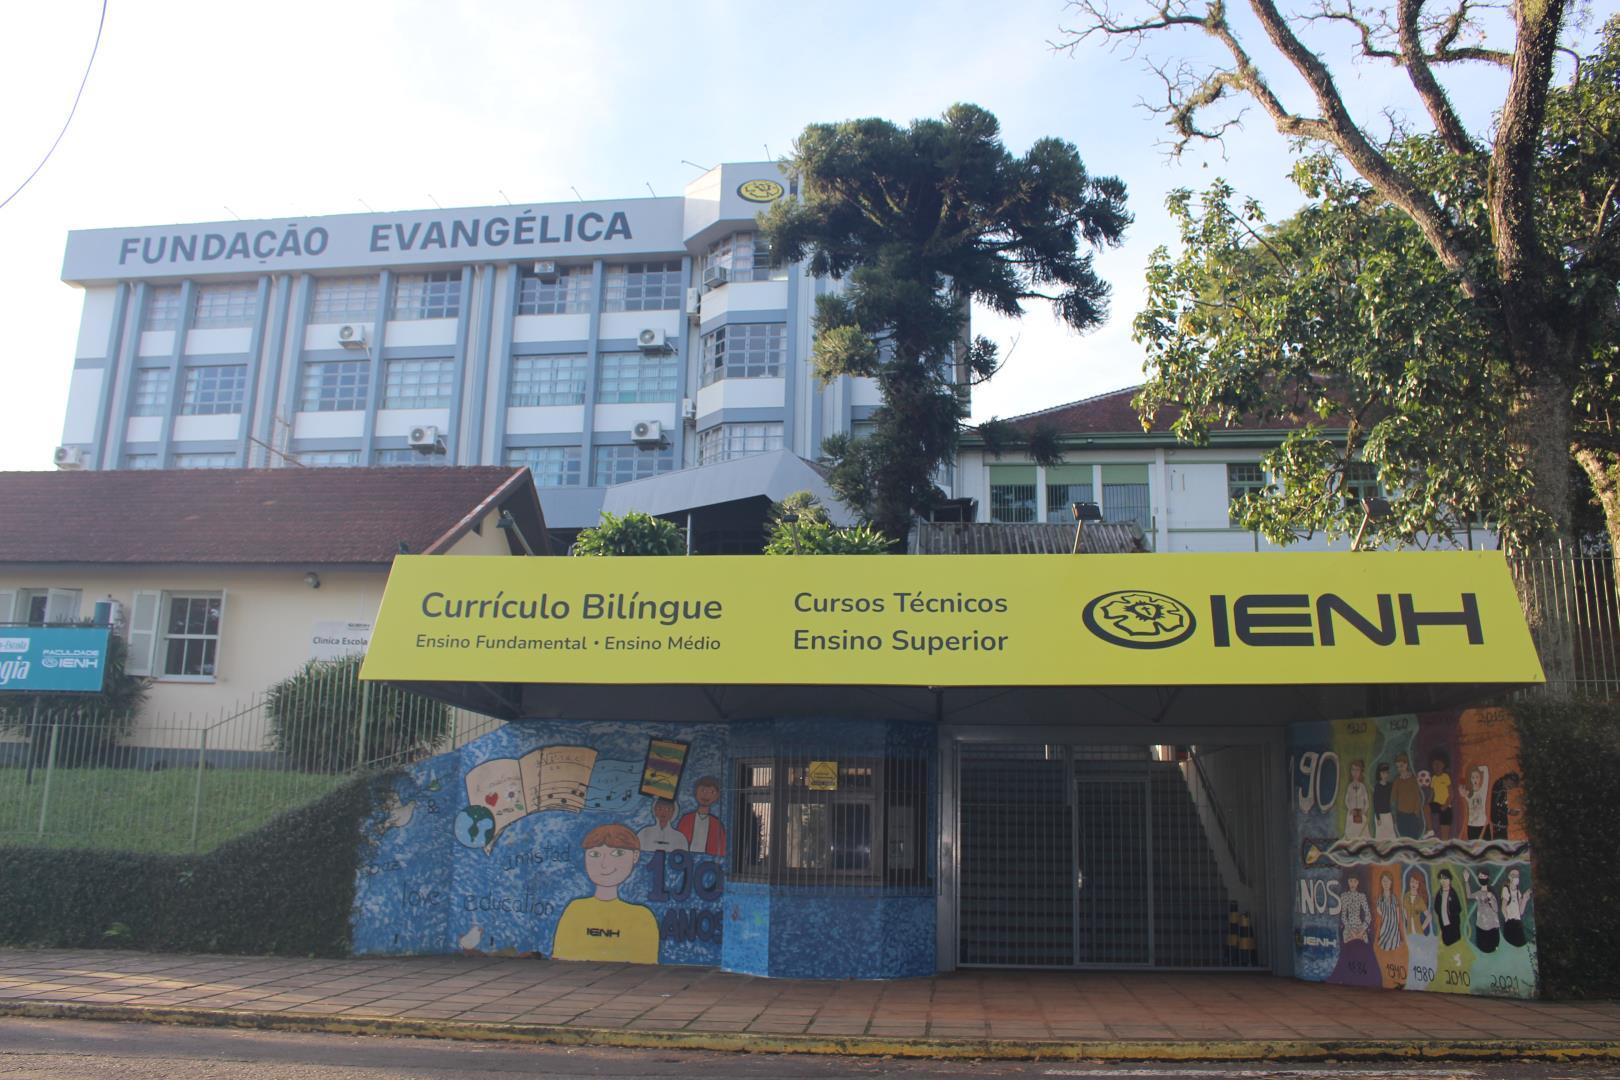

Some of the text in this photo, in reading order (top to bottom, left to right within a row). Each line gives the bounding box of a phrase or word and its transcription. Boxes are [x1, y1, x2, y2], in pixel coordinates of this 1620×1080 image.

[118, 209, 634, 266] FUNDAÇÃO EVANGÉLICA
[421, 590, 723, 626] Currículo Bilíngue
[793, 590, 1008, 613] Cursos Técnicos
[1210, 592, 1485, 648] IENH
[415, 634, 721, 651] Ensino Fundamental Ensino Médio
[793, 629, 1008, 656] Ensino Superior
[0, 656, 30, 685] gia
[58, 658, 98, 669] IENH
[401, 880, 441, 909] love
[463, 890, 555, 918] education
[586, 927, 621, 938] IENH
[1303, 935, 1337, 948] IENH
[1413, 966, 1435, 982] 1980
[1445, 969, 1471, 986] 2010
[1490, 974, 1520, 992] 2021
